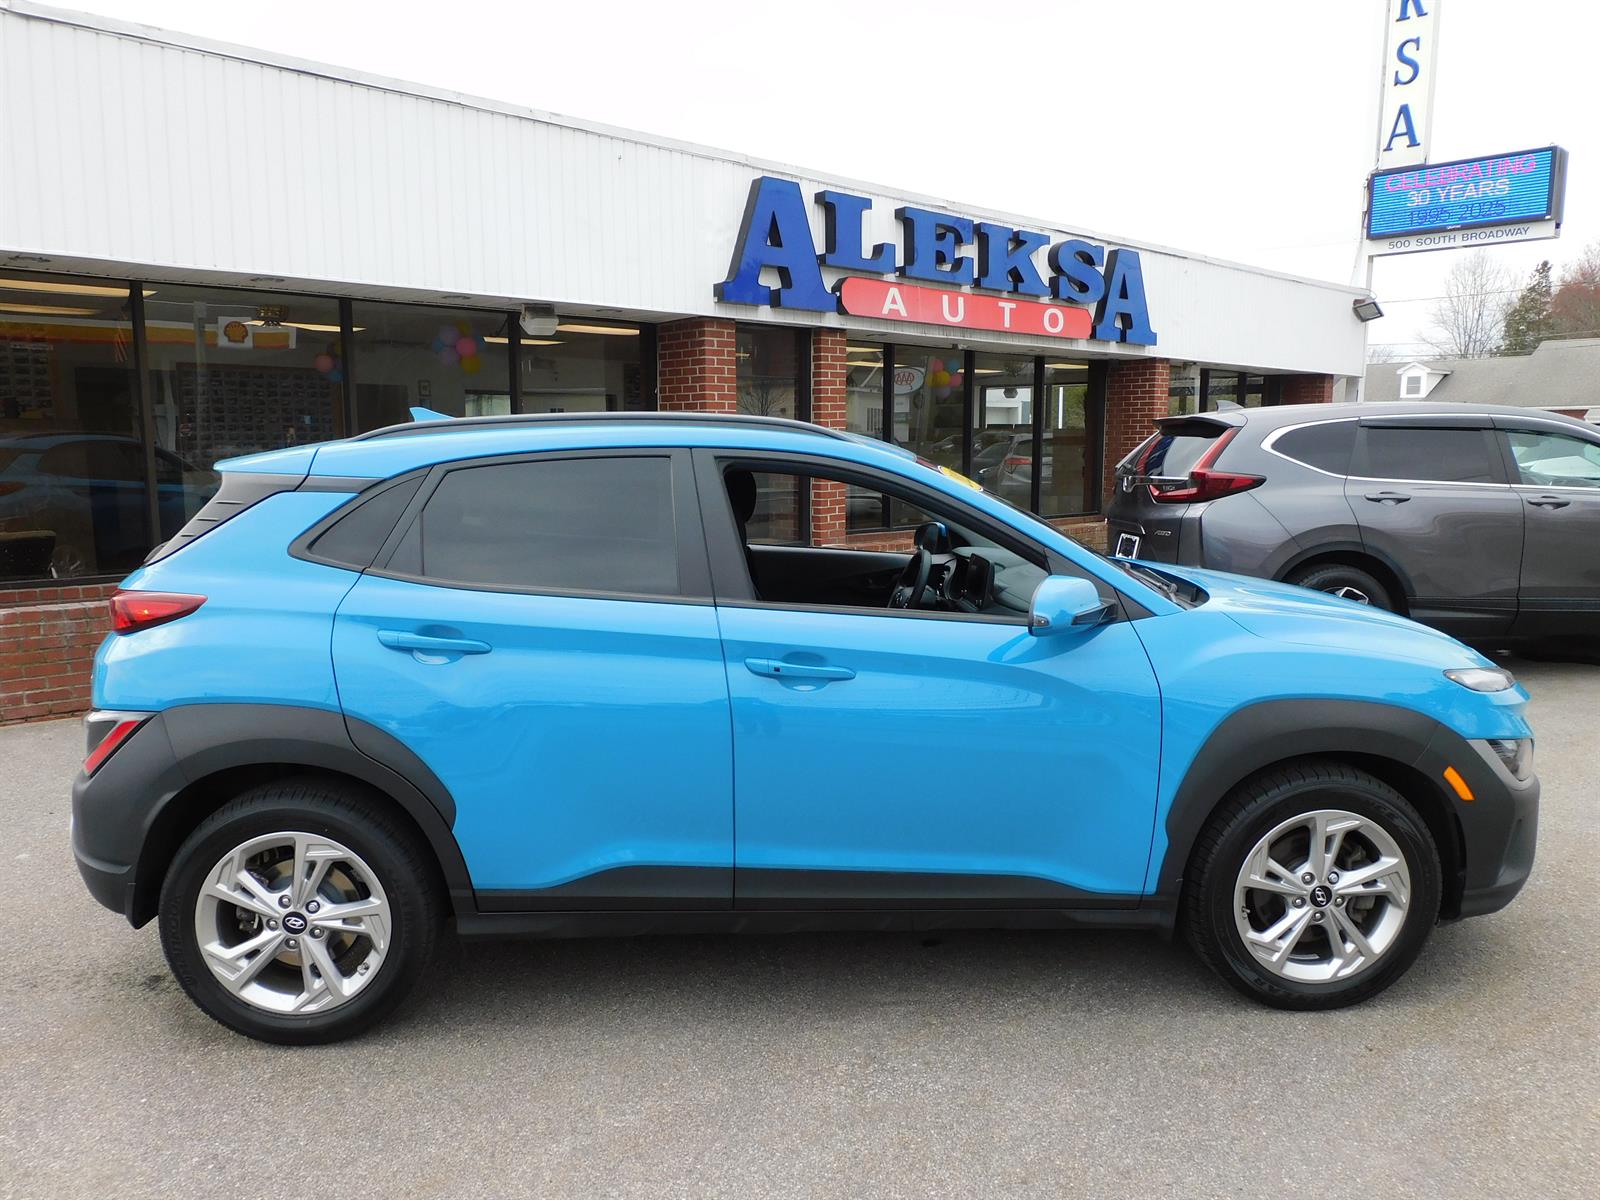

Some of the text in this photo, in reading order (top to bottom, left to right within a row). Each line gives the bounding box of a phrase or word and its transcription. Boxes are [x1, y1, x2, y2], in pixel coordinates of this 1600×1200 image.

[1385, 153, 1537, 192] CELEBRATING
[1407, 178, 1511, 206] 30 YEARS
[1388, 226, 1530, 250] 500 SOUTH BROADWAY
[714, 175, 1158, 346] ALEKSA
[881, 286, 1065, 334] AUTO
